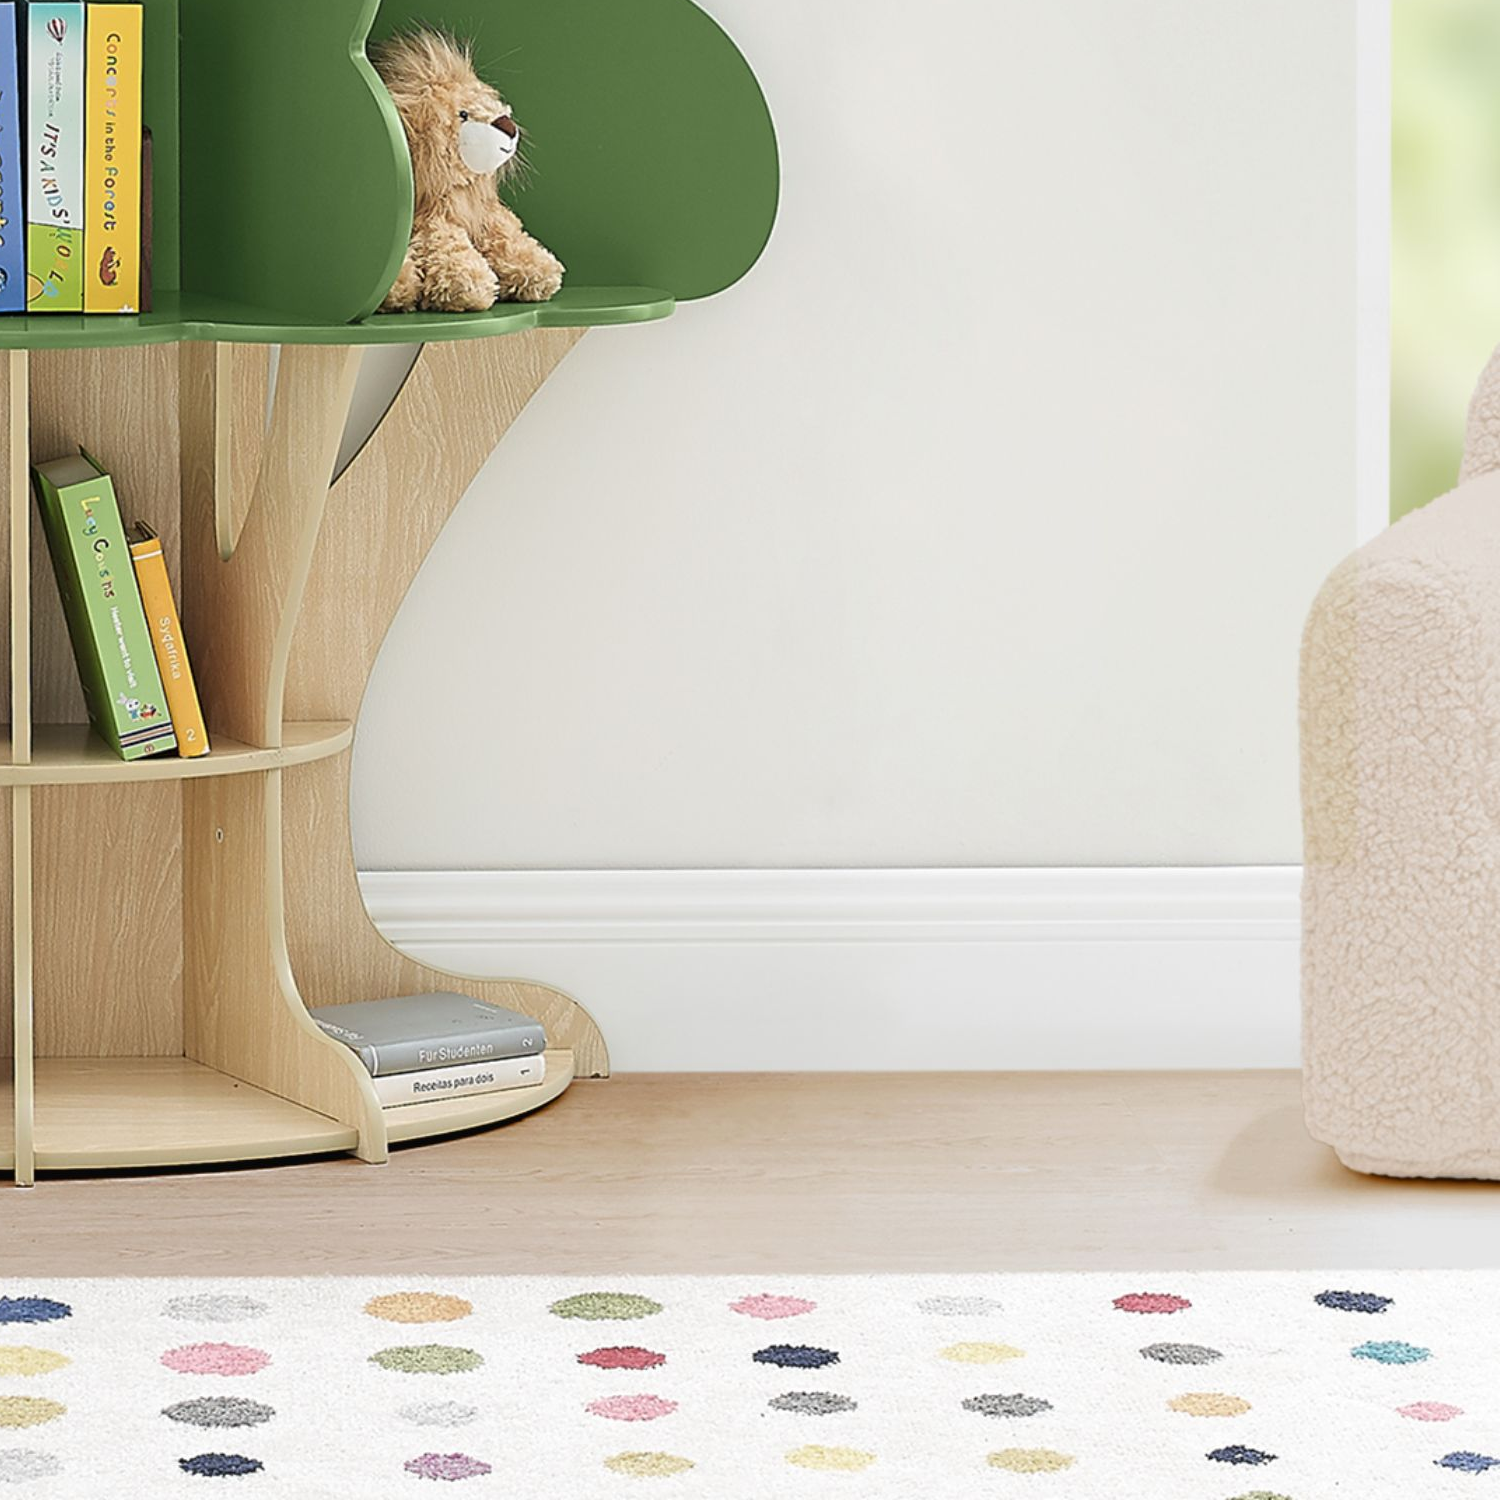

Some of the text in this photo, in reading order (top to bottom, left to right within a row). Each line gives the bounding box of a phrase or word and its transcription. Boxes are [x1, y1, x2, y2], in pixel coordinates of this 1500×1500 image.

[105, 122, 115, 134] in
[41, 123, 60, 158] IT'S
[40, 160, 55, 172] A
[81, 496, 115, 598] Lucy Cousins
[186, 728, 196, 741] 2
[522, 1038, 533, 1047] 2
[440, 1043, 493, 1061] Studenten
[453, 1076, 474, 1089] para
[475, 1072, 494, 1085] dois
